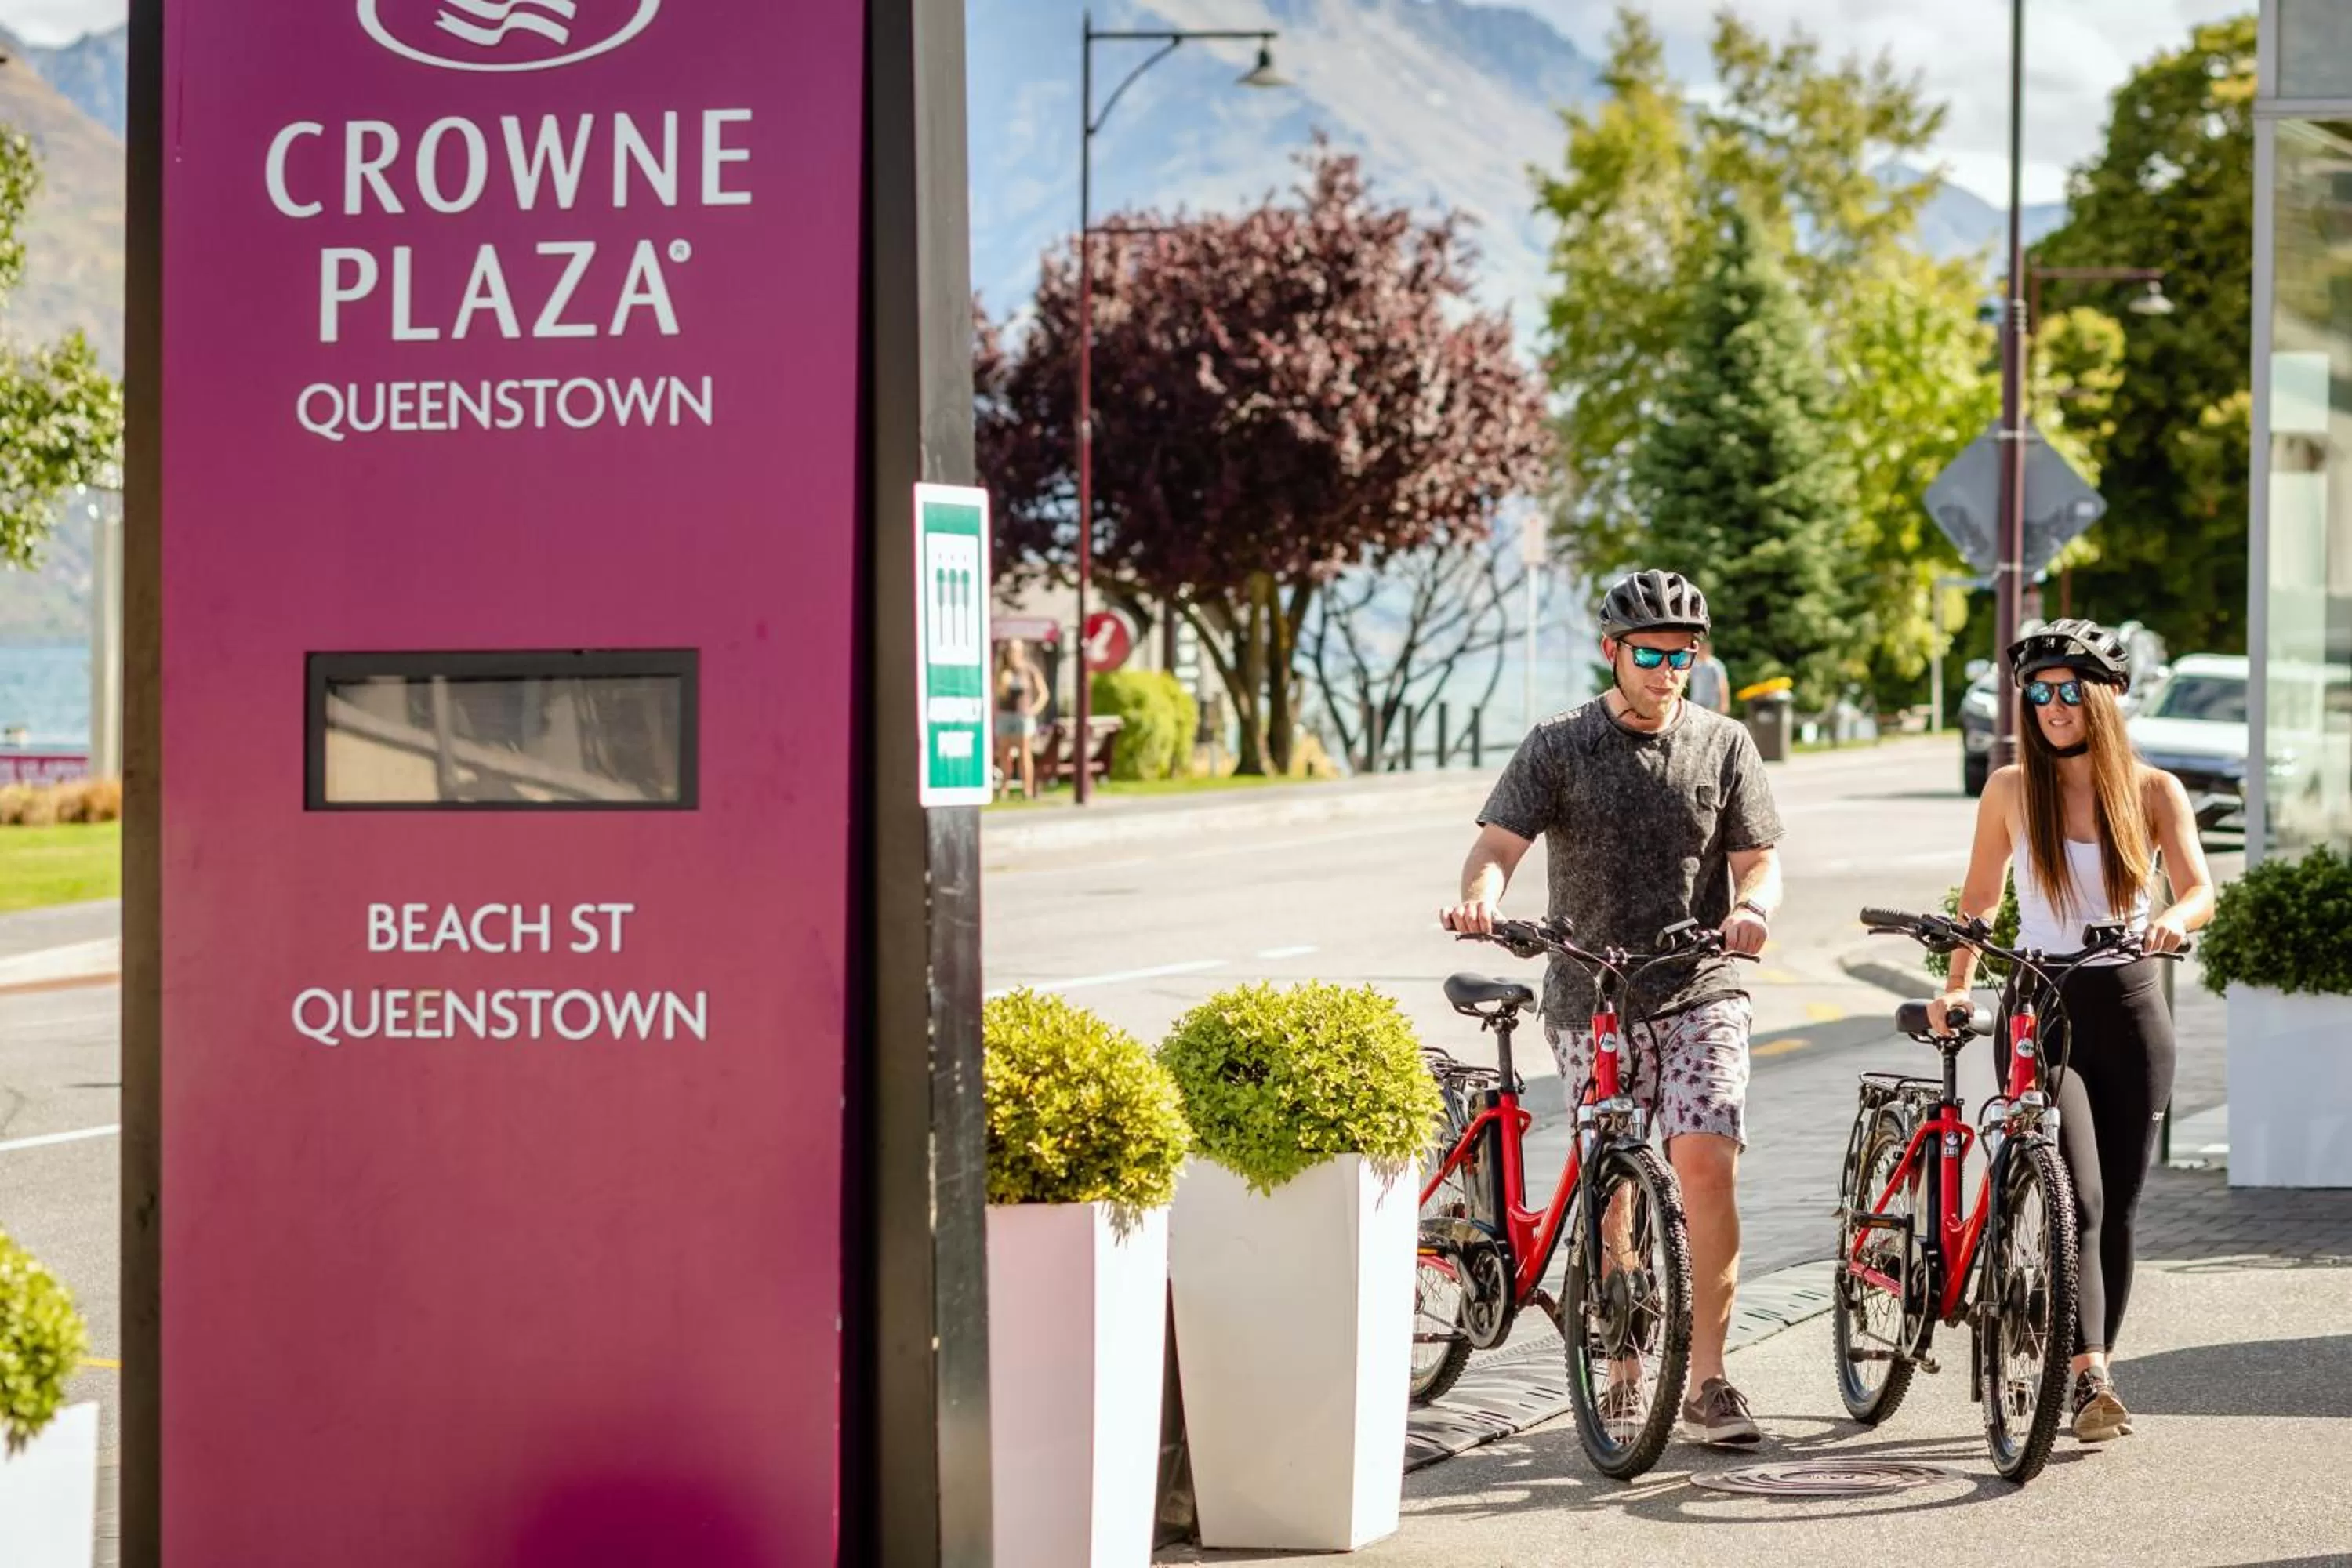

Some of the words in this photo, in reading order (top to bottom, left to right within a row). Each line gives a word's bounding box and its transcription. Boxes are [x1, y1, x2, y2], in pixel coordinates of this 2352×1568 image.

[266, 108, 752, 217] CROWNE
[297, 376, 712, 441] QUEENSTOWN
[368, 902, 550, 953] BEACH
[570, 902, 634, 953] ST
[292, 988, 706, 1046] QUEENSTOWN
